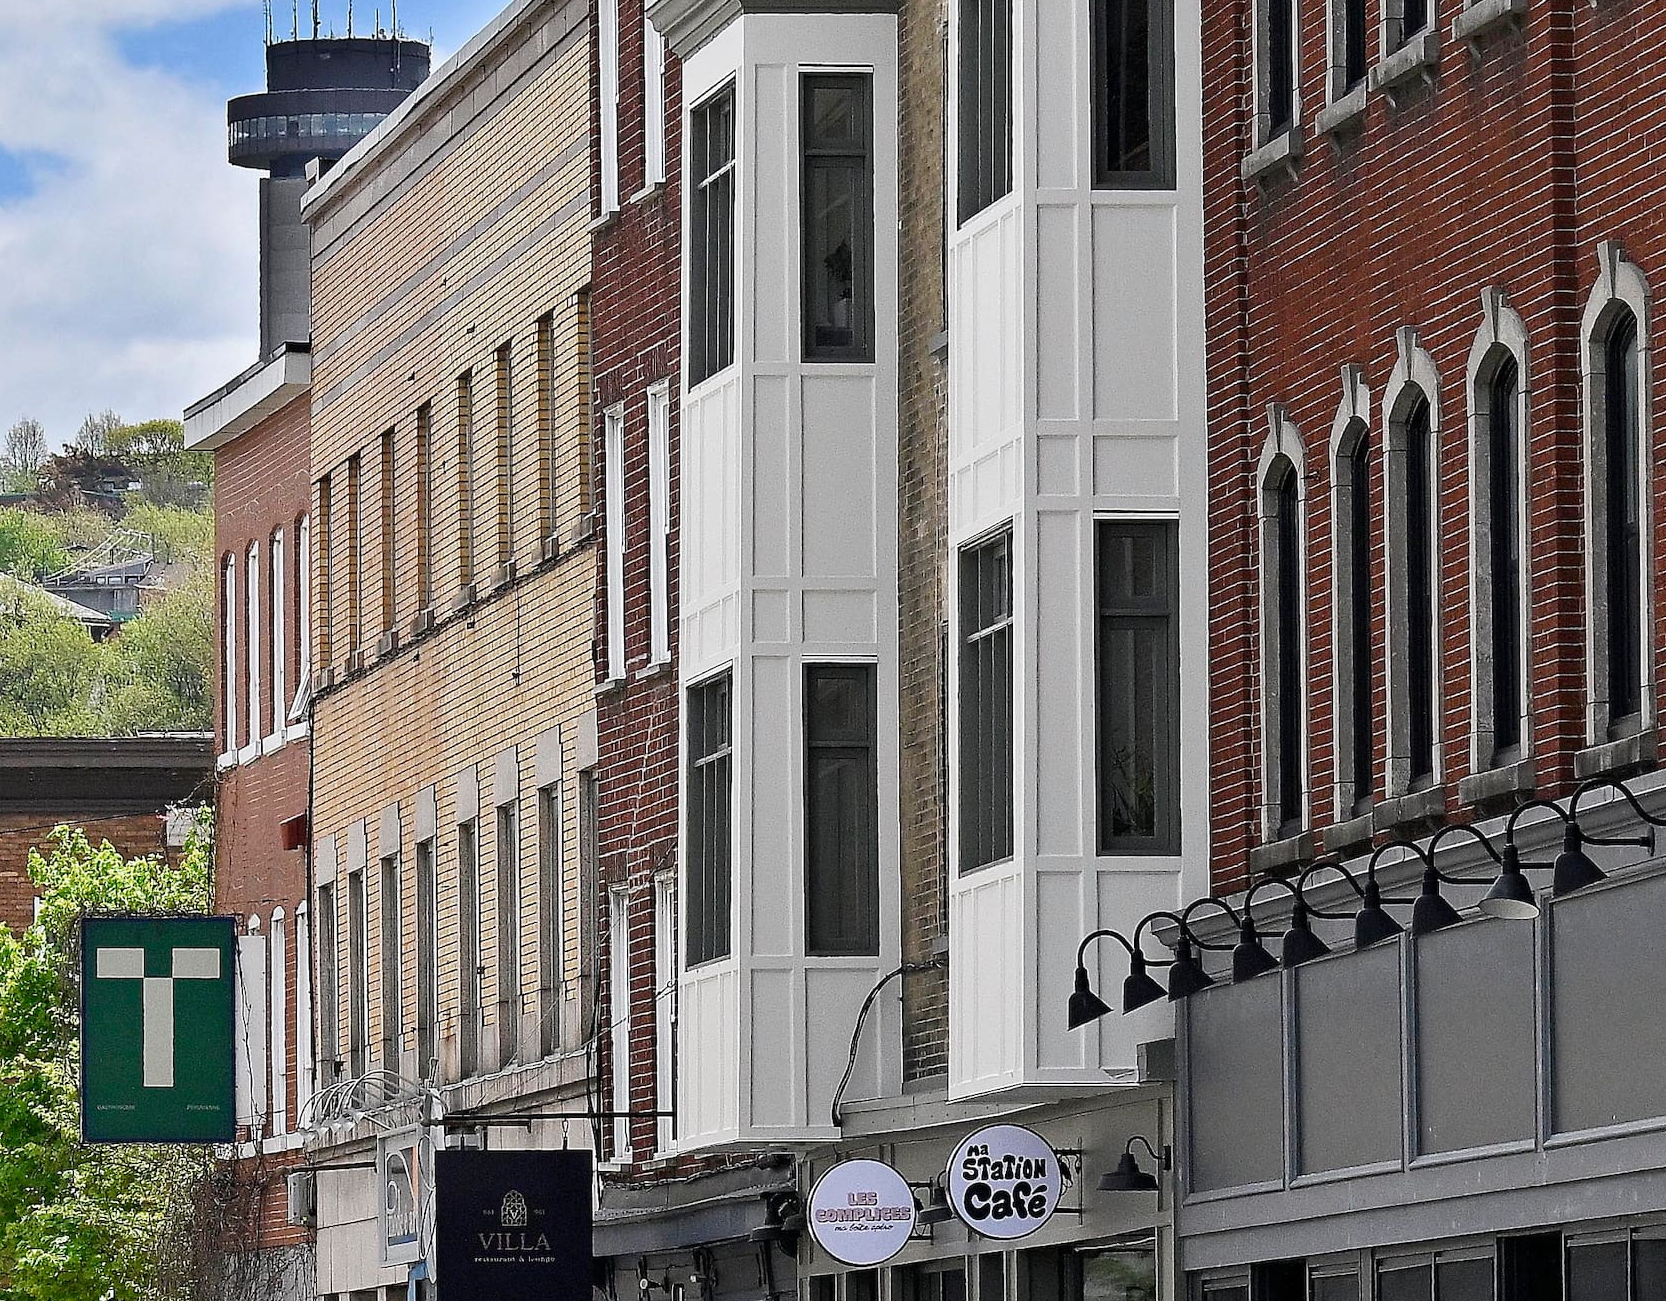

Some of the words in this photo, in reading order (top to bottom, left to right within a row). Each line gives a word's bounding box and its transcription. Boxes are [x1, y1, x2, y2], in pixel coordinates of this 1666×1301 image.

[847, 1192, 878, 1207] LES
[963, 1181, 1048, 1221] Café
[815, 1207, 911, 1223] COMPLICES
[477, 1232, 552, 1251] VILLA
